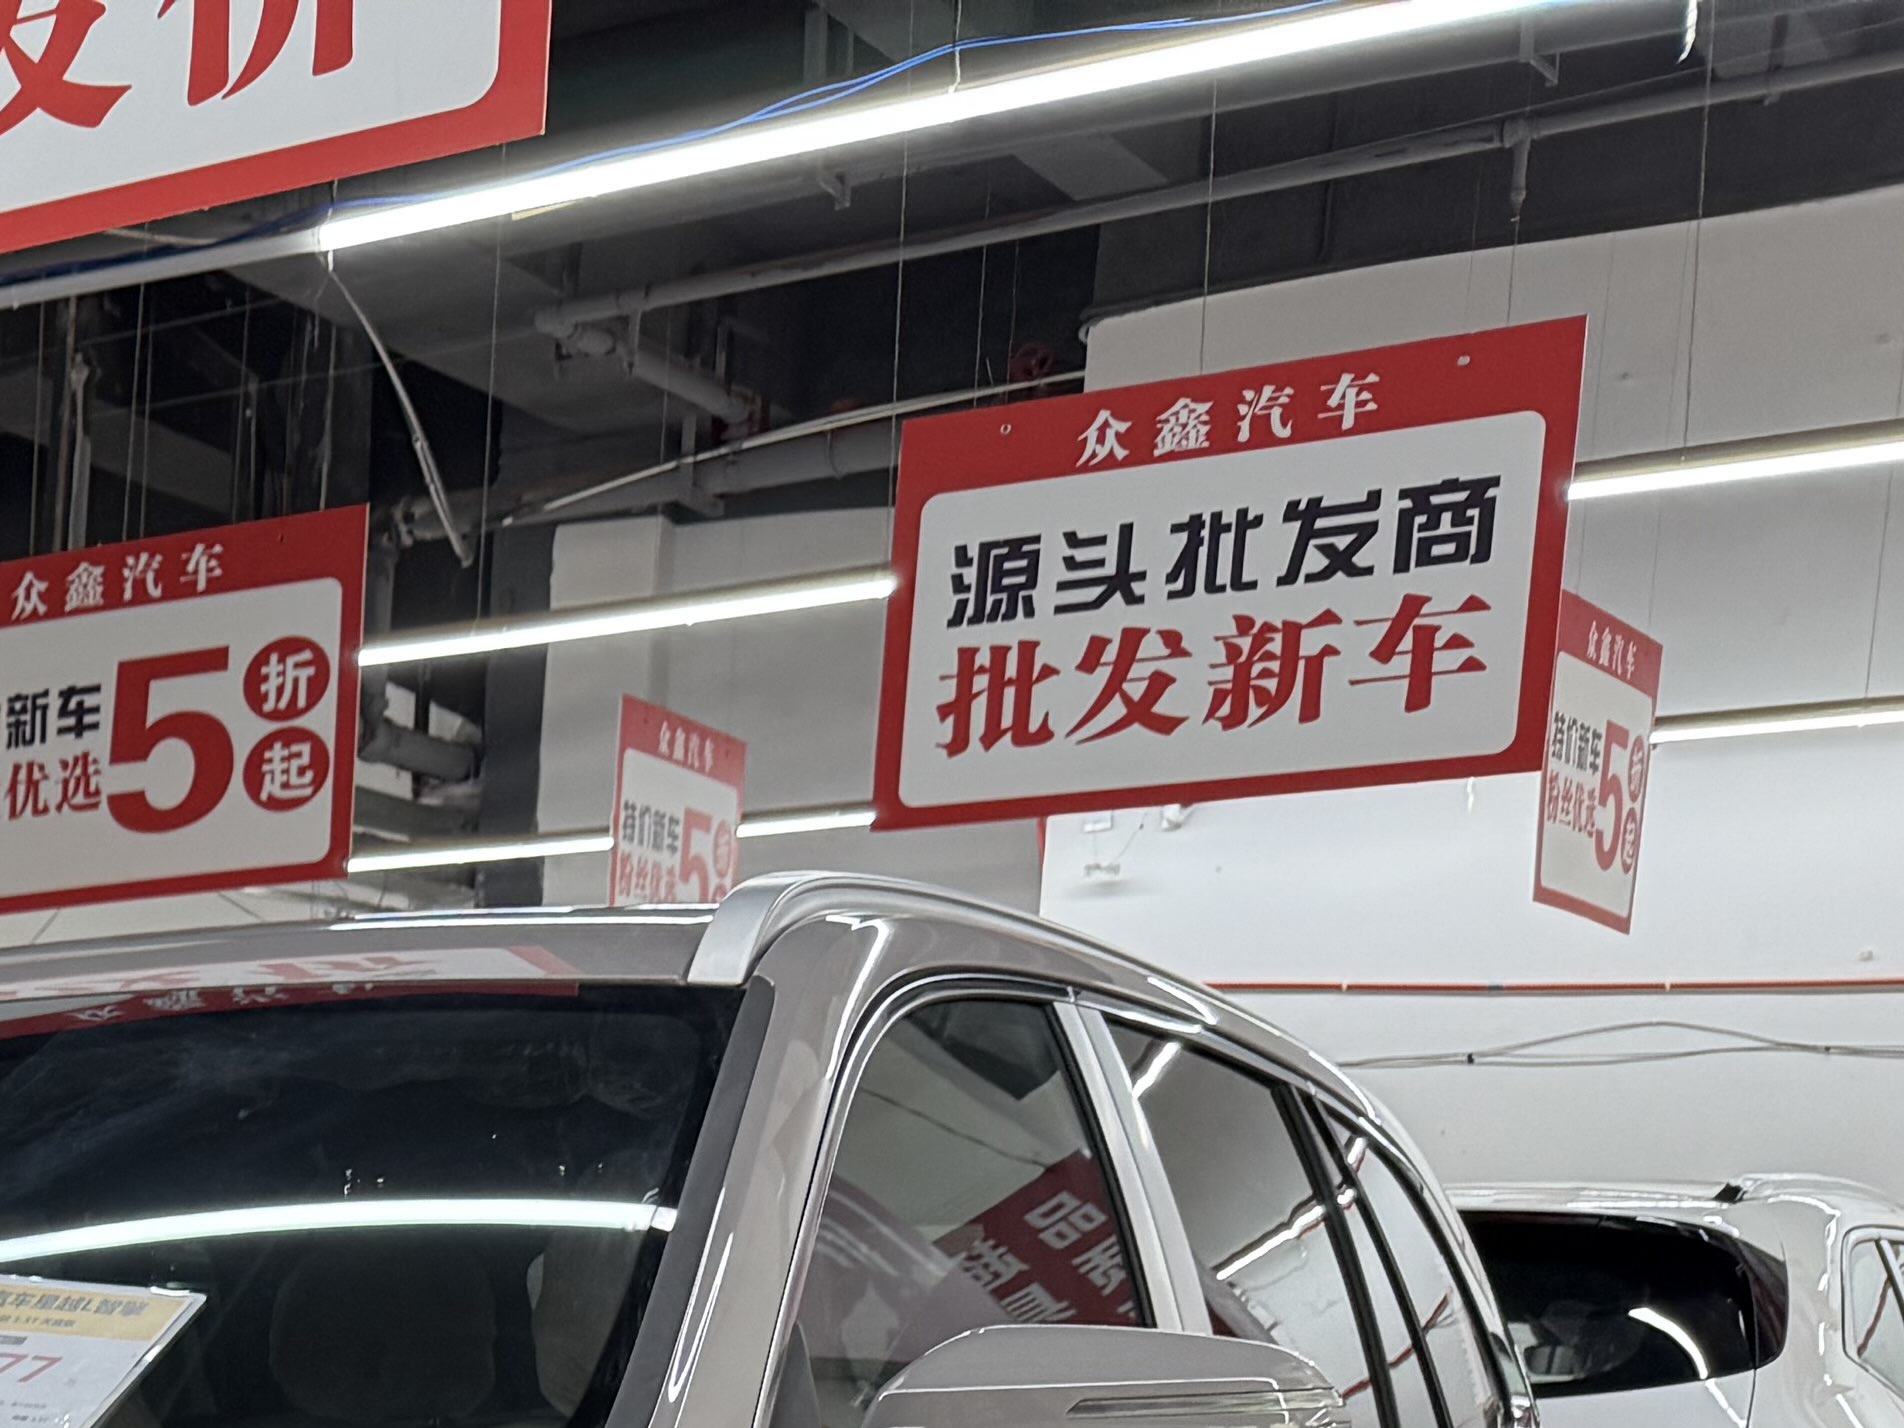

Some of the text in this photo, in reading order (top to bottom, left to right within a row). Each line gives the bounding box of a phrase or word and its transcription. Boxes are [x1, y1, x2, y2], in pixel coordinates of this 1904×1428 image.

[1075, 370, 1380, 468] 众鑫汽车
[9, 540, 226, 622] 众鑫汽车
[946, 474, 1501, 628] 源头批发商
[104, 645, 235, 835] 5
[935, 592, 1488, 759] 批发新车
